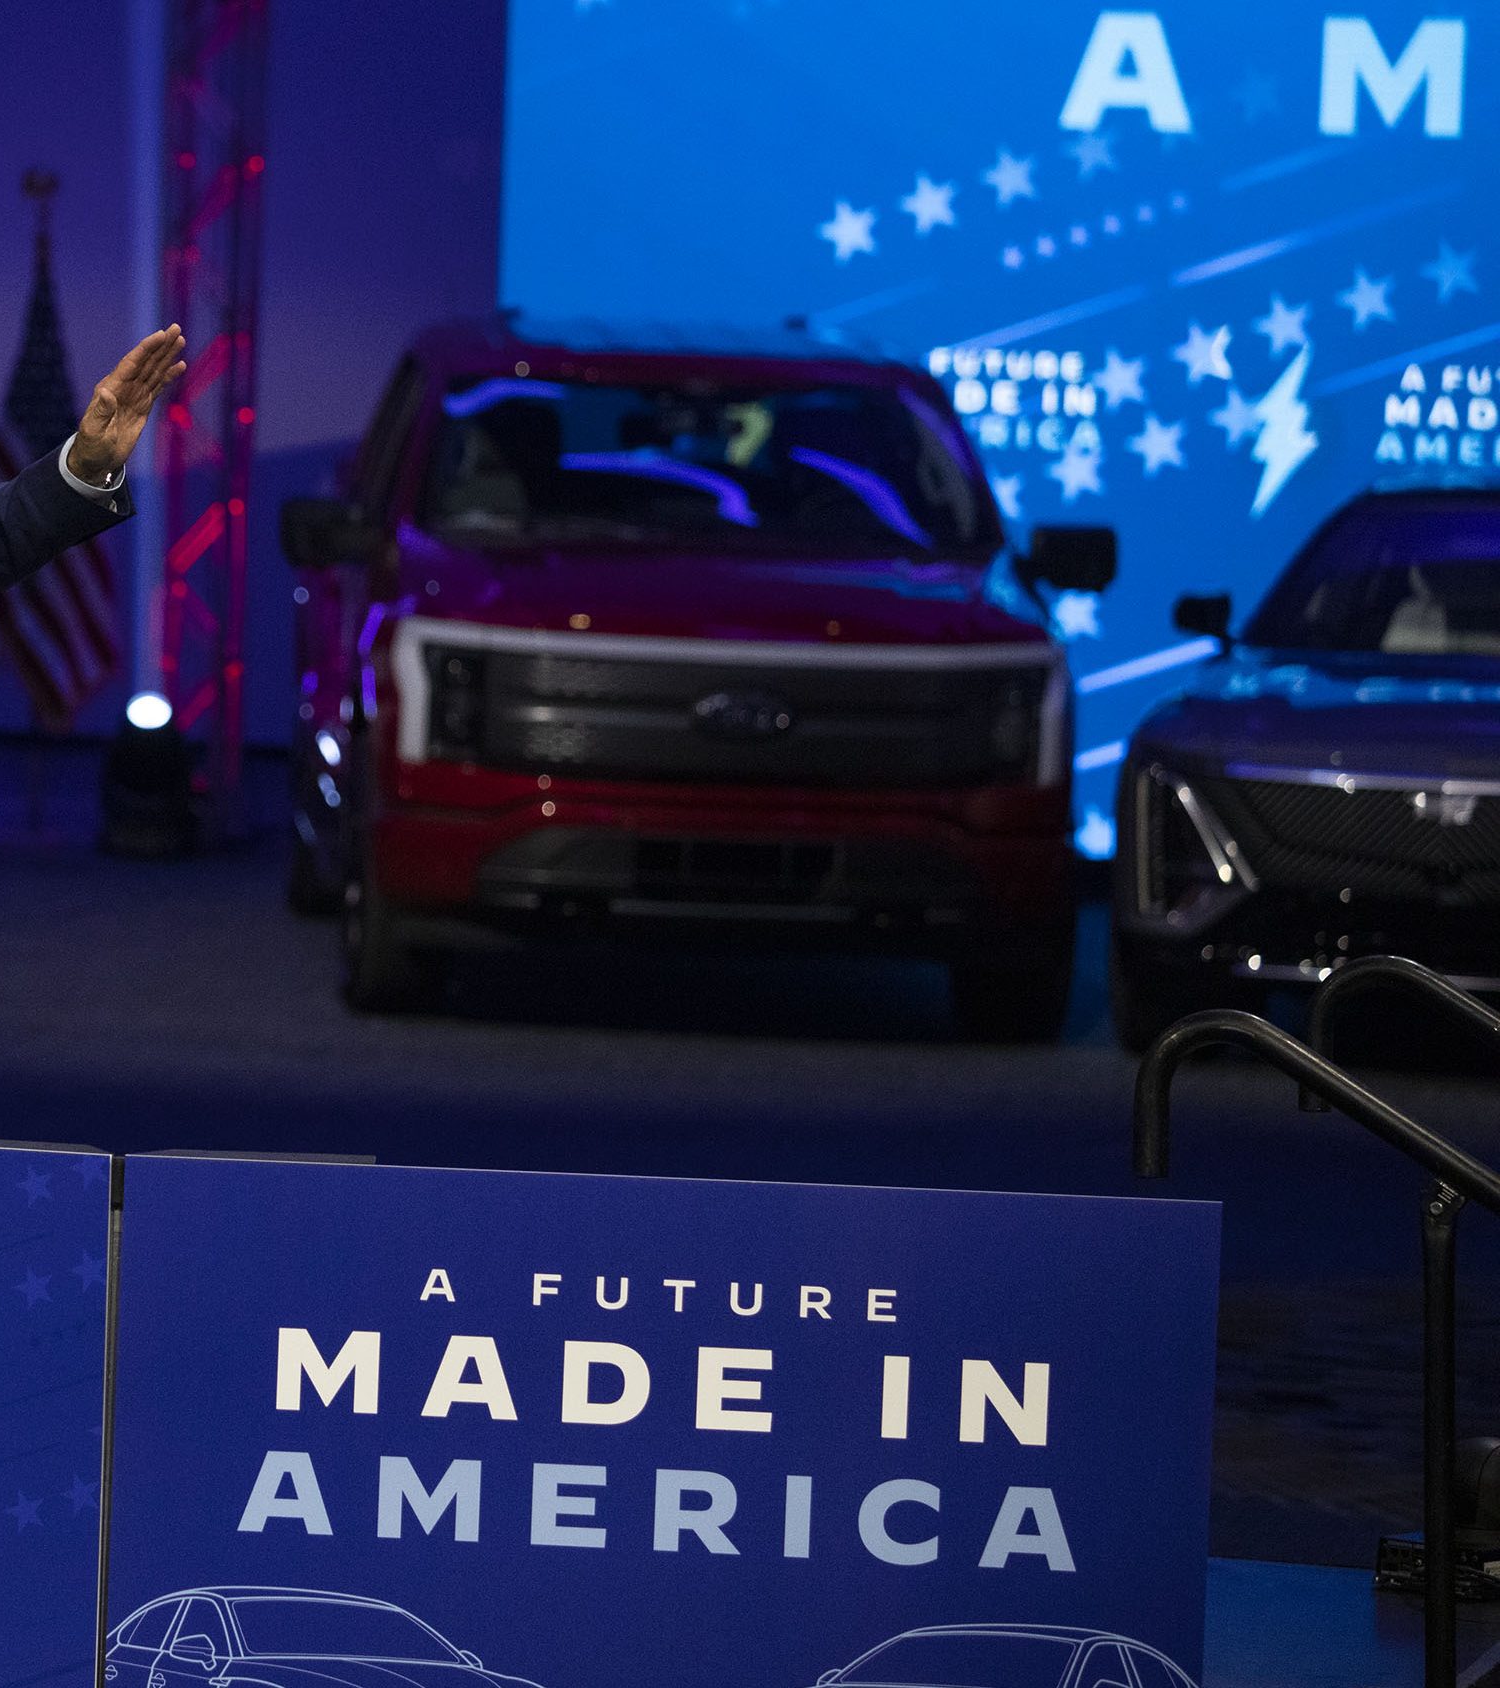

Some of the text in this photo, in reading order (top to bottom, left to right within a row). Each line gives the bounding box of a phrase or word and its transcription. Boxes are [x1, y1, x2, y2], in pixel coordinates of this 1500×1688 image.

[1440, 364, 1500, 396] FU
[1373, 428, 1500, 467] AME
[419, 1268, 897, 1323] A FUTURE
[275, 1327, 1050, 1446] MADE IN
[236, 1450, 1076, 1572] AMERICA
